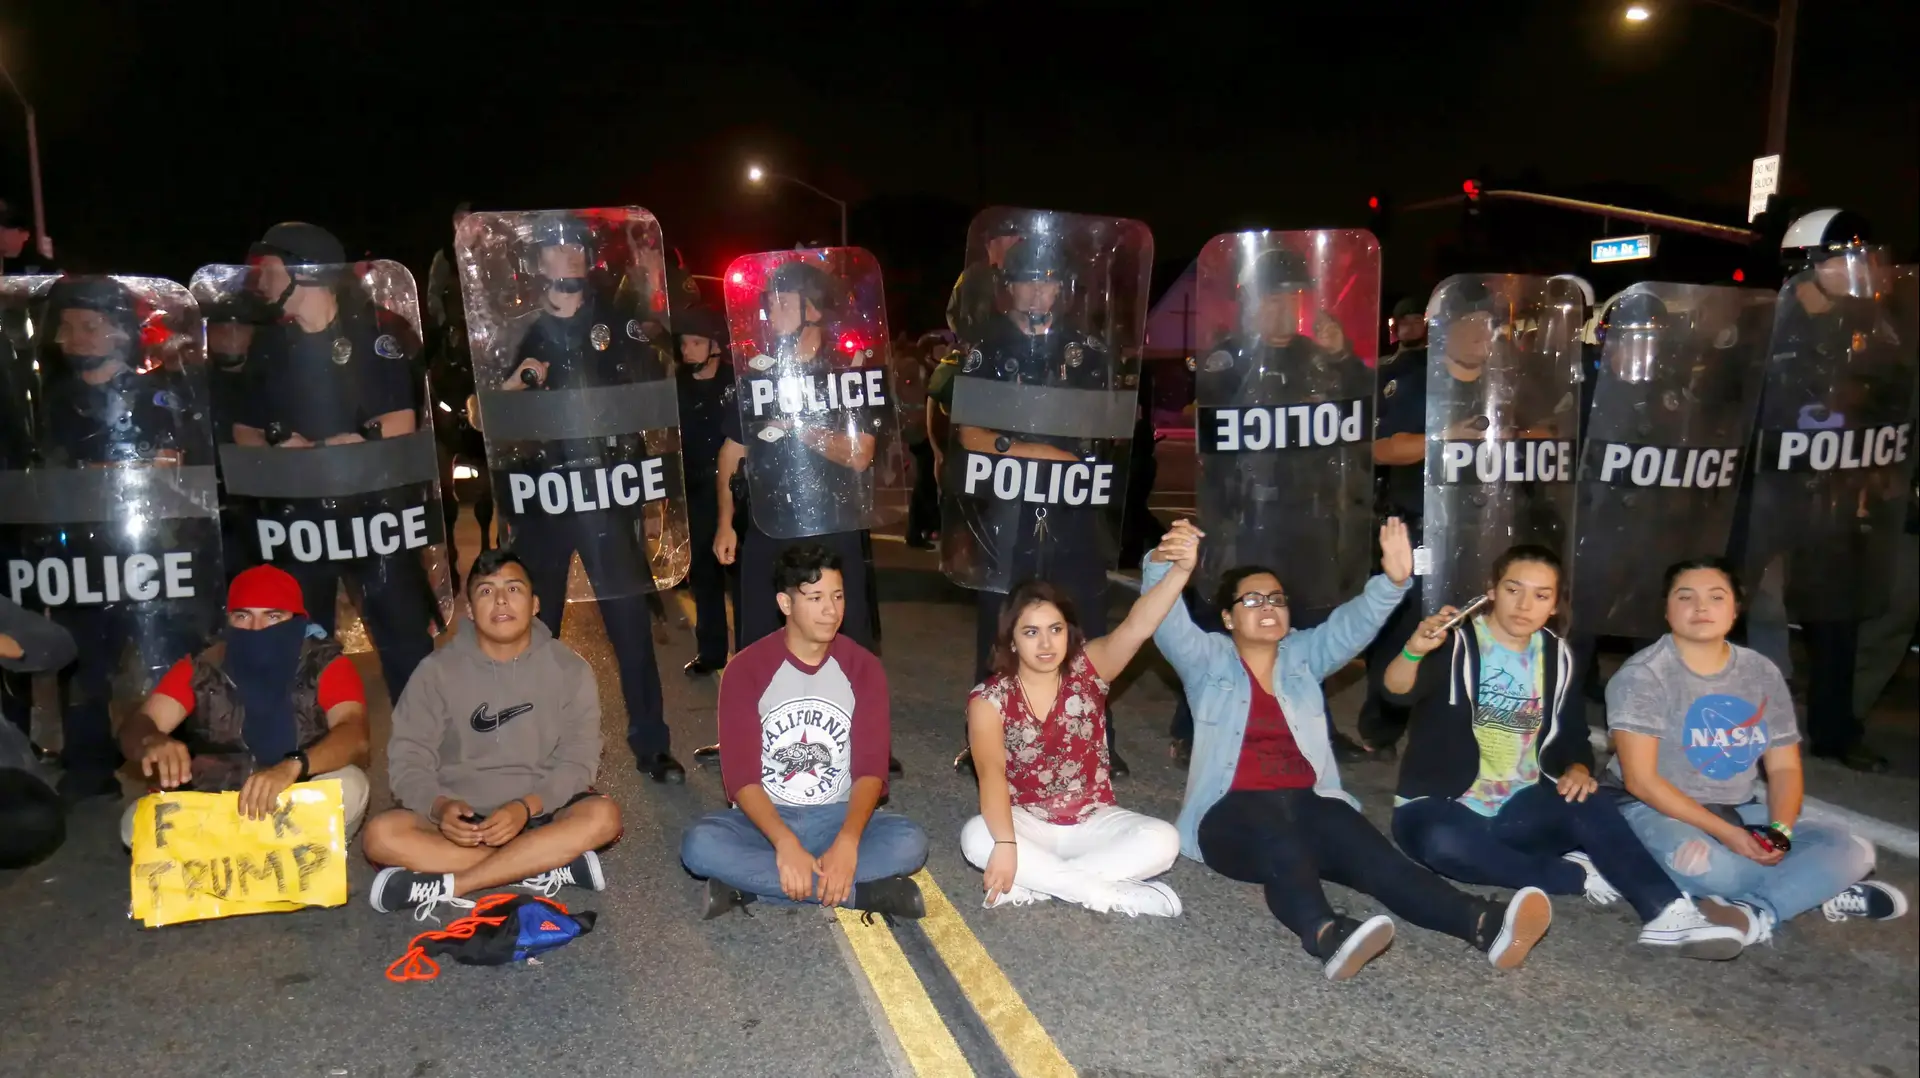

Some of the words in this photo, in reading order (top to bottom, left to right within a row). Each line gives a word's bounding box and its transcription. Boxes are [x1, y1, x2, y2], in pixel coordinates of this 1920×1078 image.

[752, 370, 885, 416] POLICE
[1216, 400, 1363, 451] POLICE
[1778, 423, 1910, 471] POLICE
[509, 457, 667, 515] POLICE
[965, 453, 1114, 506] POLICE
[1446, 440, 1570, 483] POLICE
[1600, 443, 1739, 489] POLICE
[256, 505, 428, 563] POLICE
[8, 552, 196, 606] POLICE
[1689, 726, 1767, 747] NASA
[135, 842, 332, 909] TRUMP
